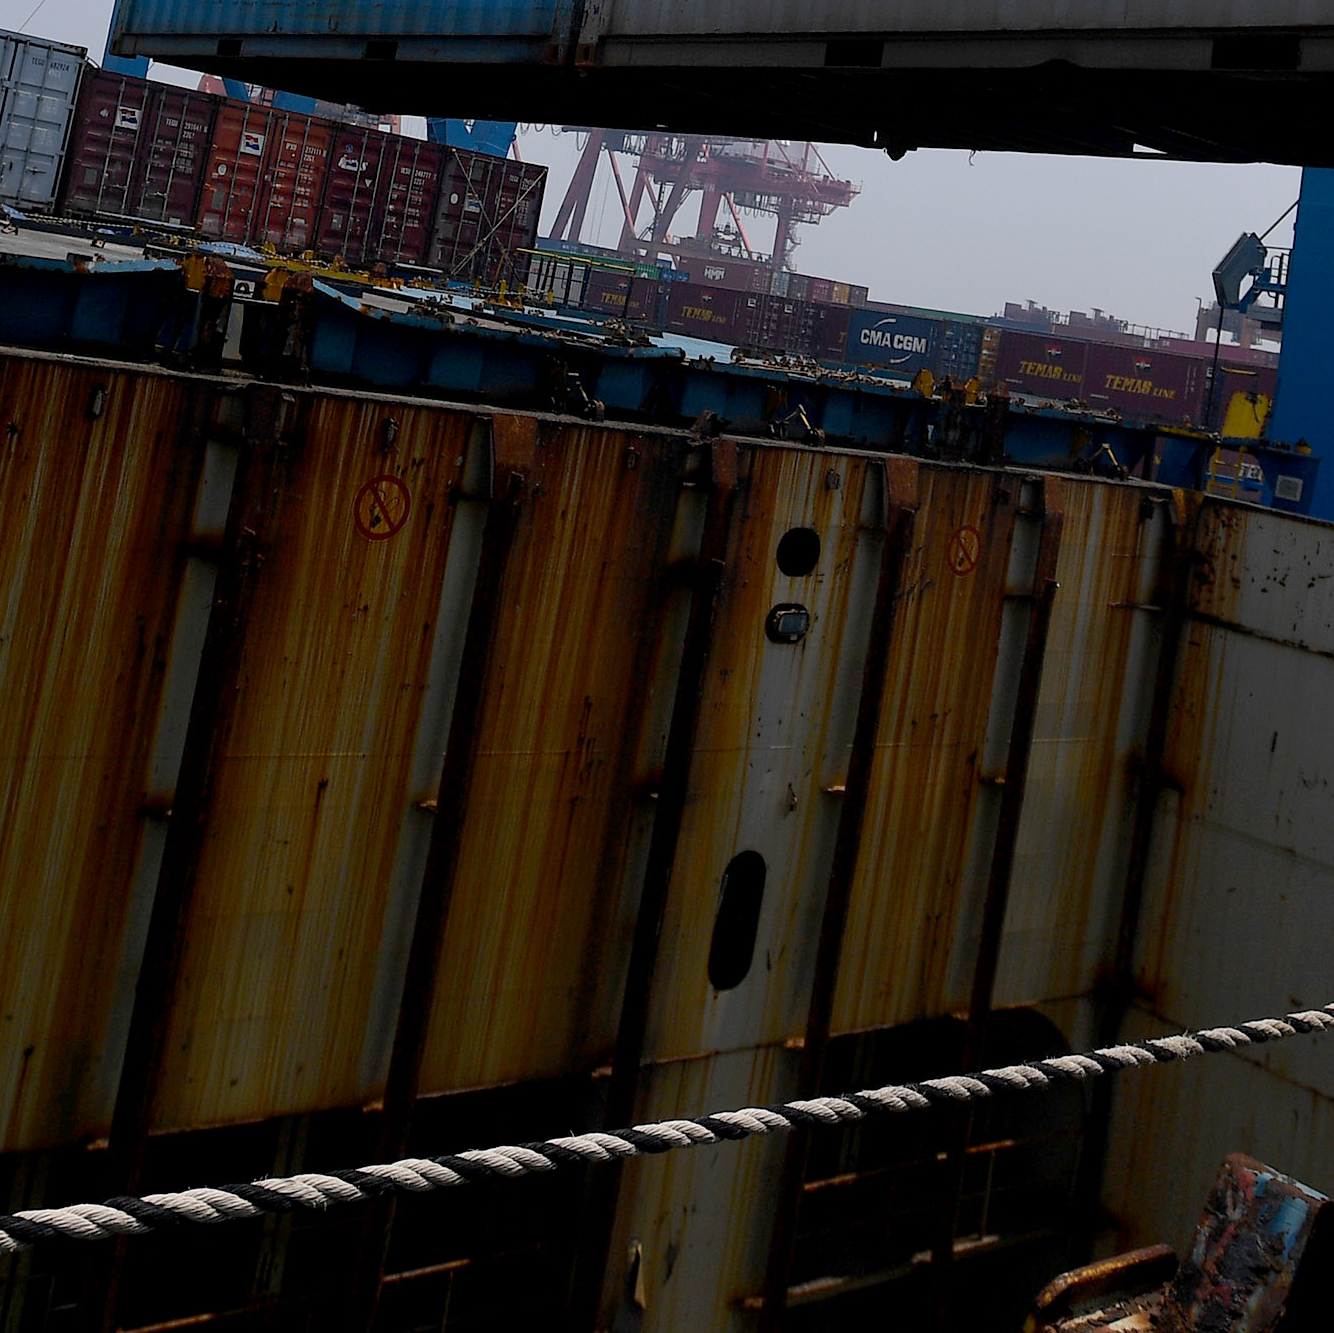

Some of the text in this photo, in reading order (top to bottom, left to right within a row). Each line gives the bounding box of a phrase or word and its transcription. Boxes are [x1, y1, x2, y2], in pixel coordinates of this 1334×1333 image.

[31, 56, 45, 67] TEGU
[704, 265, 725, 281] HMM
[601, 292, 628, 307] TEMAS
[681, 305, 713, 323] TEMAS
[860, 328, 892, 348] CMA
[893, 333, 927, 354] CGM
[1019, 361, 1063, 380] TEMAS
[1105, 374, 1176, 400] TEMAS LINE
